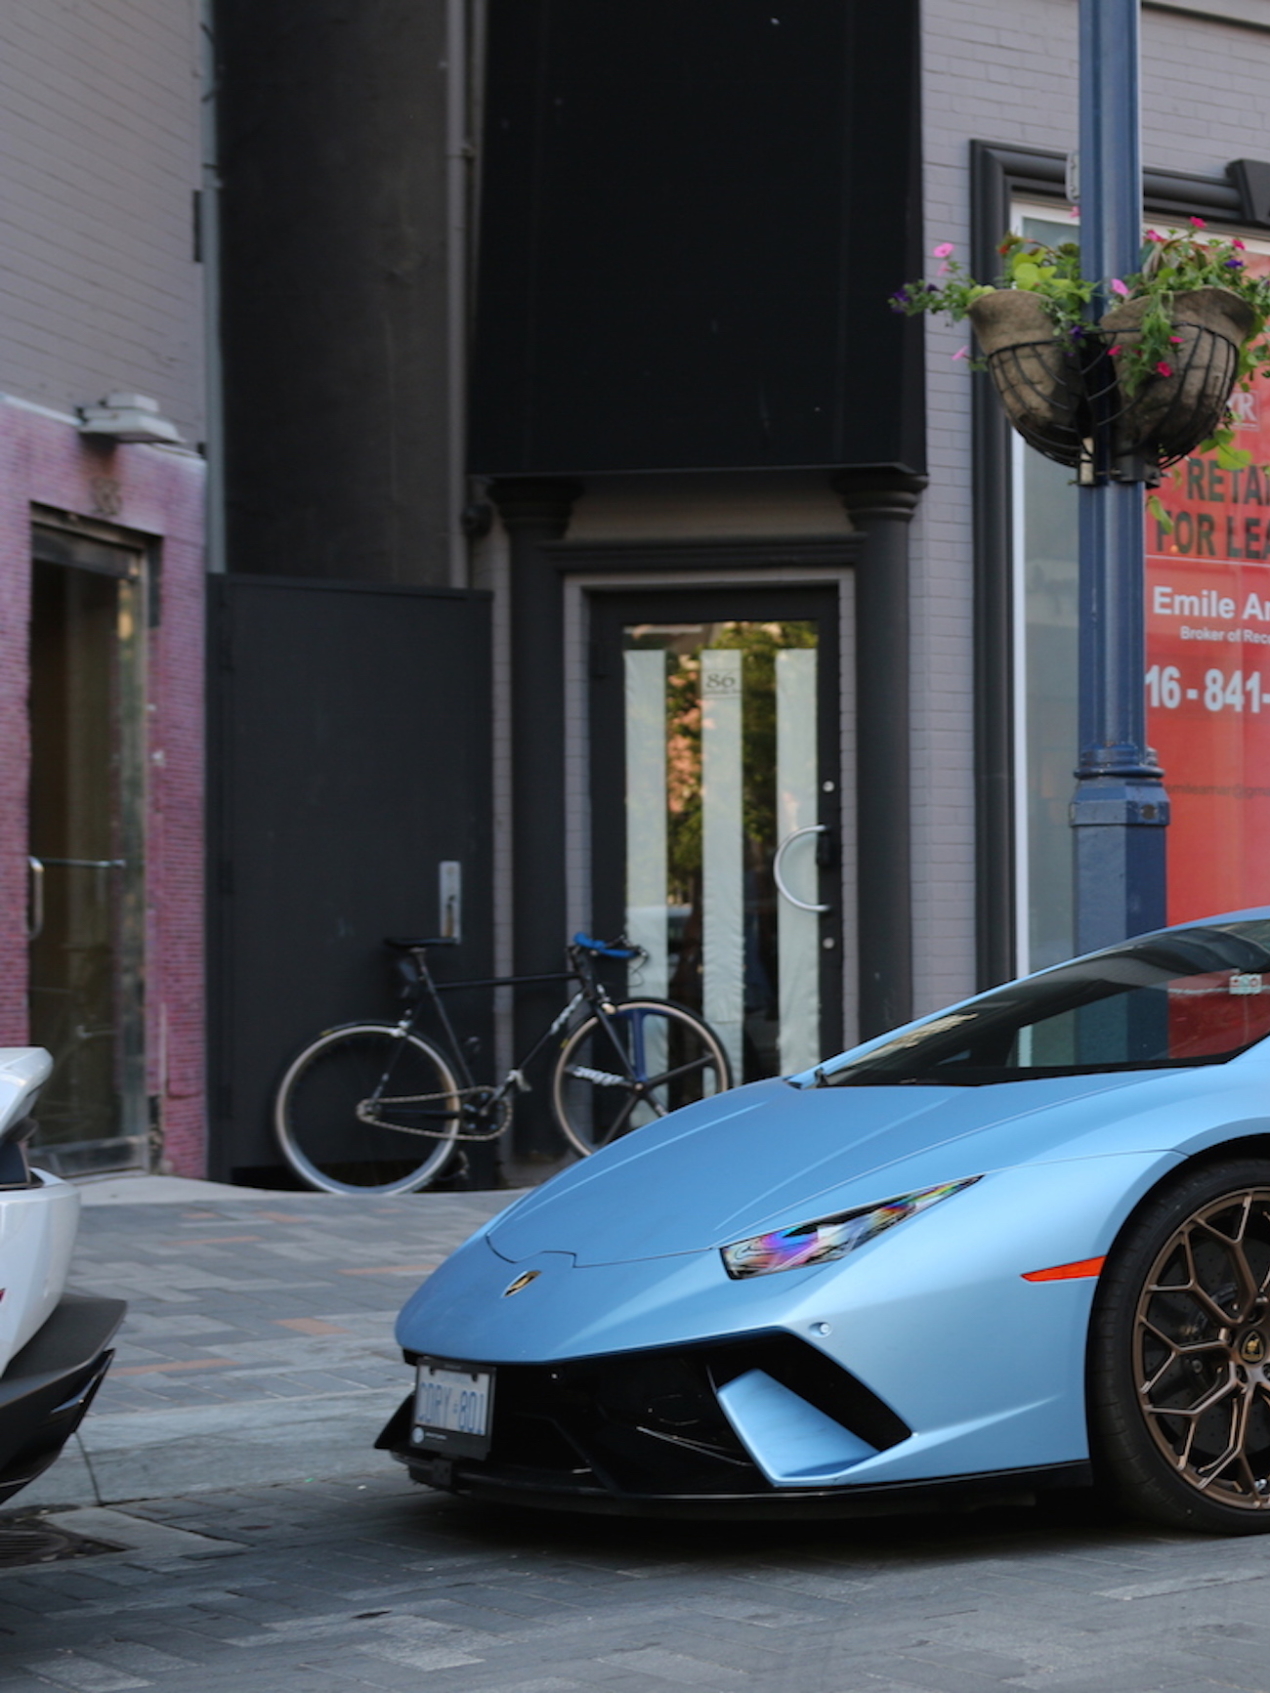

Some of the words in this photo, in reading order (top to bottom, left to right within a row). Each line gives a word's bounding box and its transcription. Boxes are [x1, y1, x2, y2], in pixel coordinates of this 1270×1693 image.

[1156, 510, 1216, 556] FOR
[1153, 586, 1235, 619] Emile
[1180, 626, 1223, 641] Broker
[1227, 628, 1241, 643] of
[1144, 664, 1181, 709] 16
[459, 1390, 484, 1433] 801
